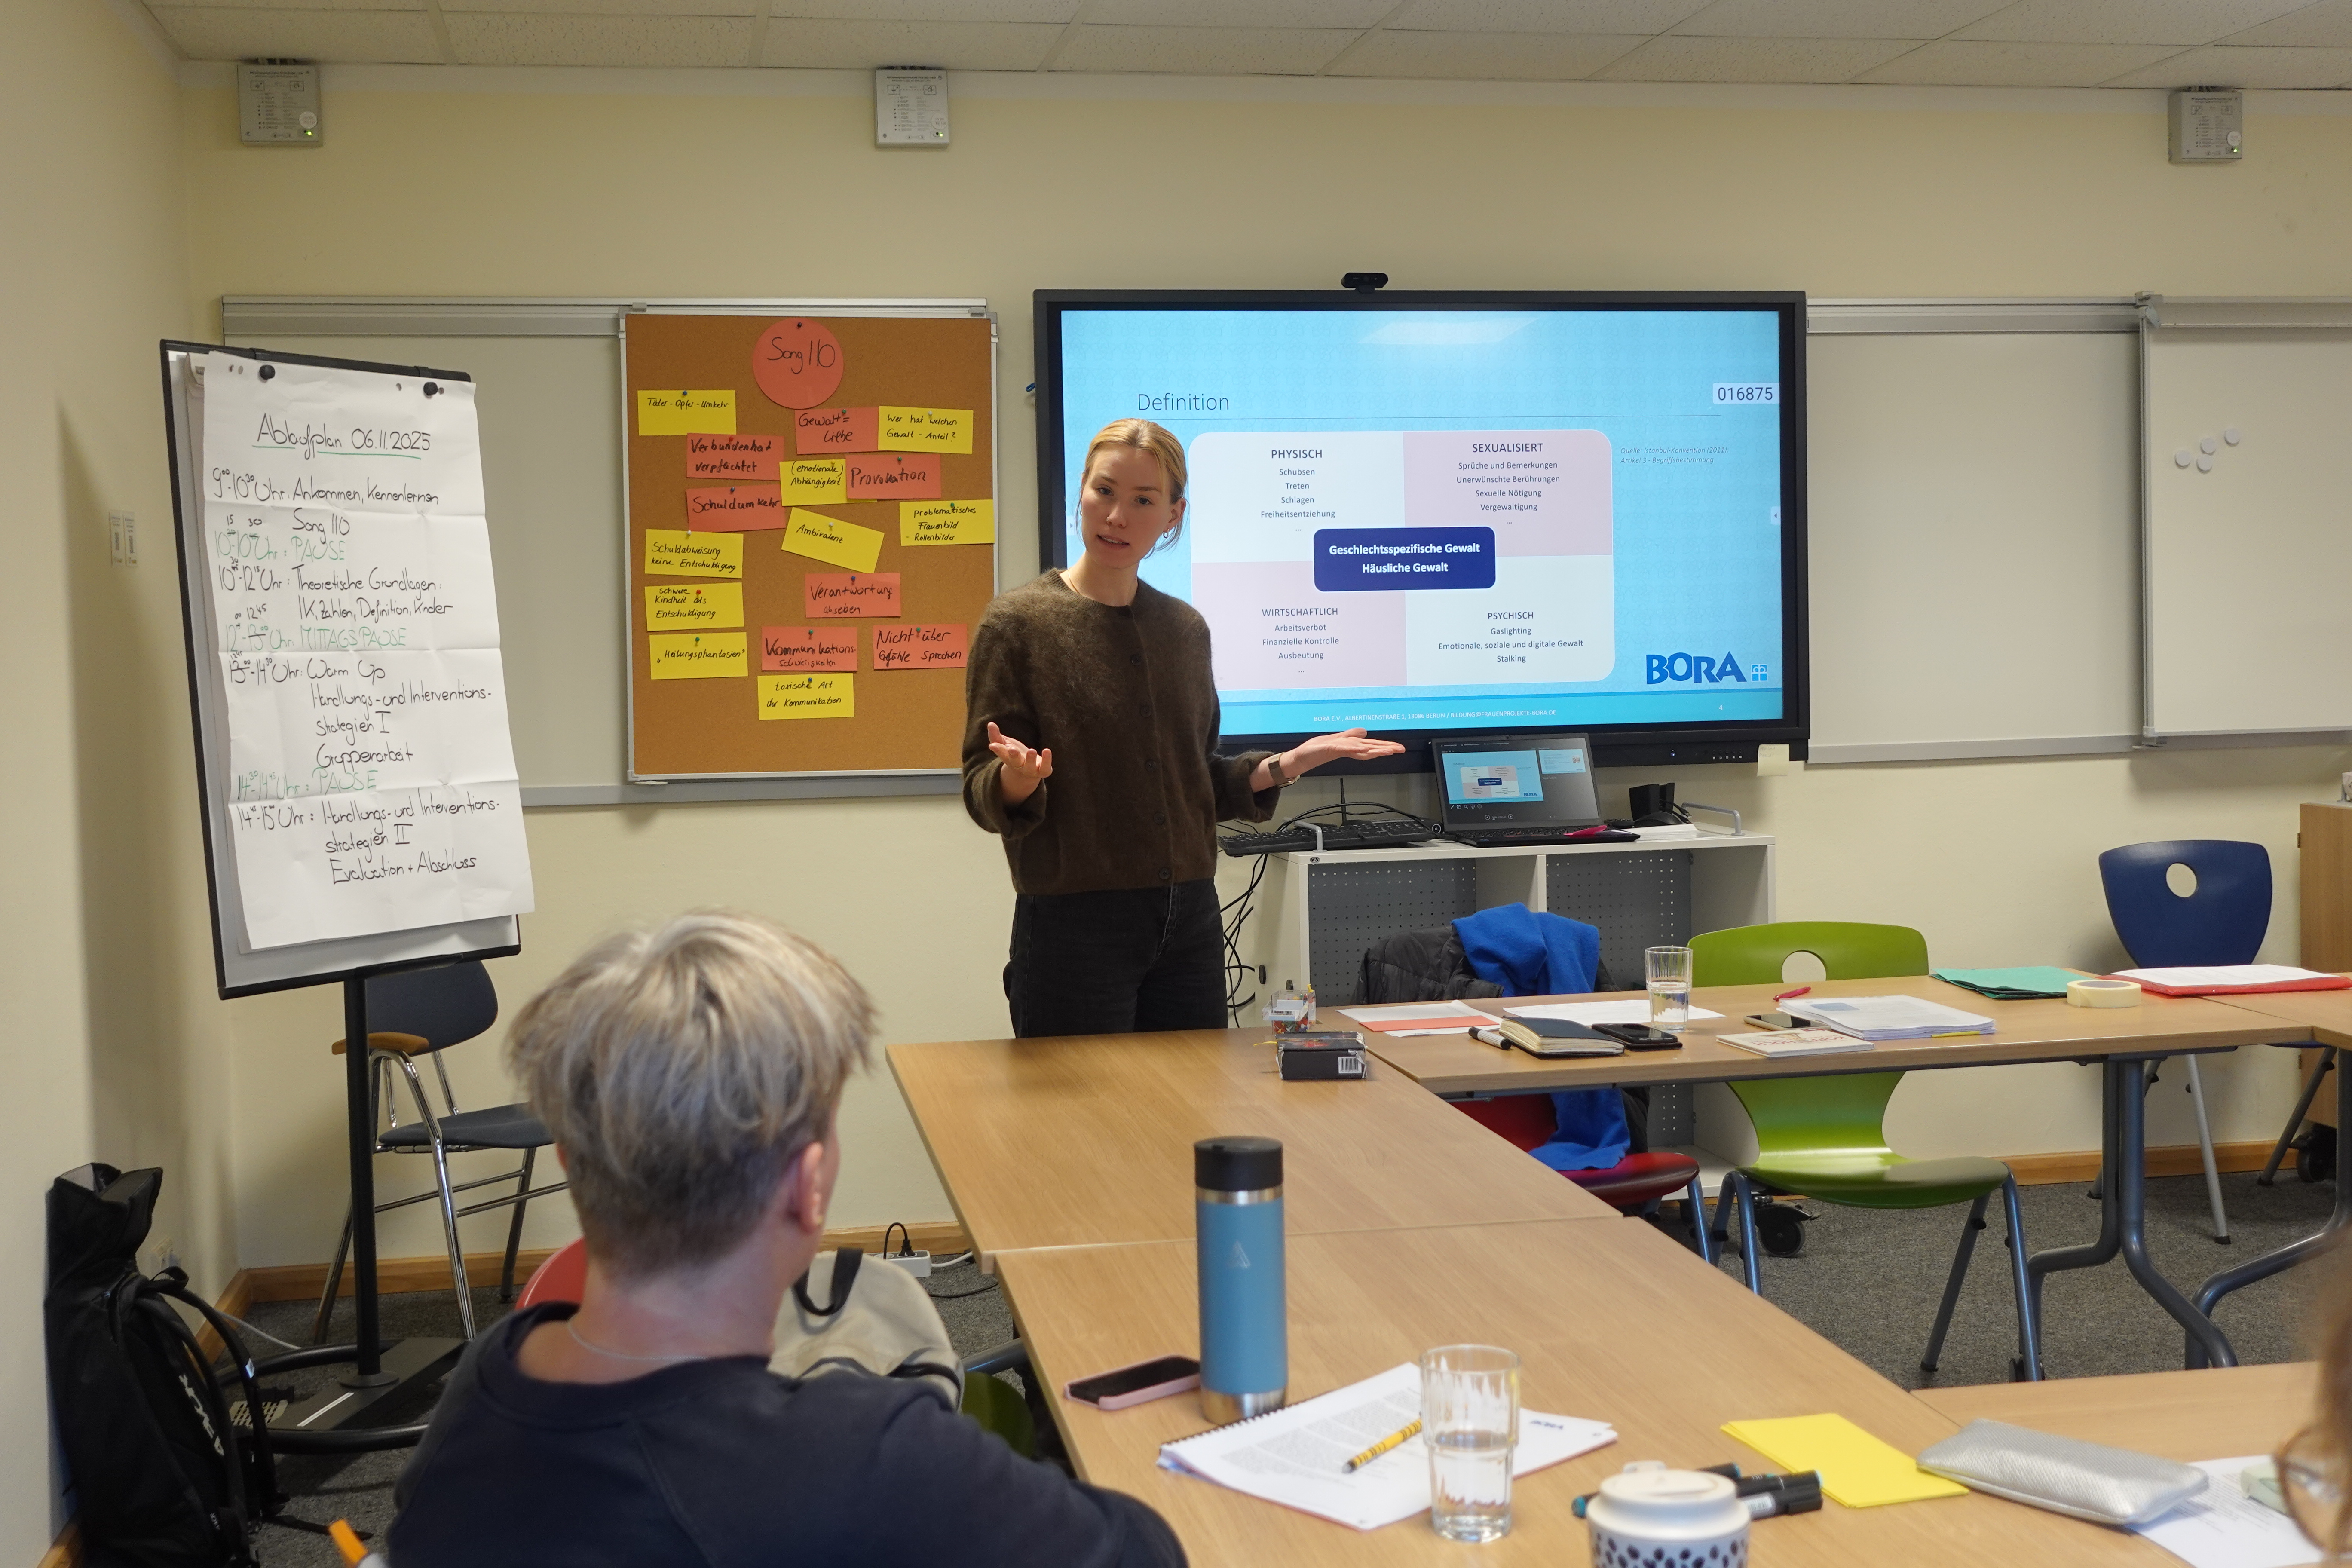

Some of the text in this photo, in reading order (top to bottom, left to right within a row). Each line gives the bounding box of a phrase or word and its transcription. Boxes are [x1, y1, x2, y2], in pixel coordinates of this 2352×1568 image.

[767, 337, 836, 374] Song 110
[1718, 386, 1774, 401] 016875
[675, 399, 694, 410] Opfer
[701, 399, 729, 408] Umkehr
[1138, 392, 1230, 411] Definition
[910, 414, 923, 423] hat
[929, 417, 958, 426] welchen
[257, 413, 431, 460] Ablaufplan 06.11.2025
[824, 430, 853, 443] Liebe
[886, 428, 914, 438] Gewalt
[1271, 448, 1323, 459] PHYSISCH
[1472, 443, 1544, 453] SEXUALISIERT
[1620, 446, 1729, 455] Quelle: Istanbul-Konvention (2011):
[1458, 460, 1558, 471] Sprüche und Bemerkungen
[1620, 456, 1642, 464] Artikel
[1652, 456, 1715, 465] Begriffsbestimmung
[791, 461, 844, 477] (emotionale)
[1279, 467, 1316, 476] Schubsen
[790, 476, 841, 488] Abhängigkeit
[851, 467, 926, 488] Provokation
[1456, 475, 1561, 484] Unerwünschte Berührungen
[293, 475, 364, 504] Ankommen,
[367, 477, 439, 505] Kennenlernen
[1285, 482, 1310, 490] Treten
[1475, 489, 1542, 499] Sexuelle Nötigung
[1280, 496, 1315, 505] Schlagen
[913, 506, 977, 518] problematisches
[1480, 503, 1538, 512] Vergewaltigung
[1260, 509, 1336, 519] Freiheitsentziehung
[292, 507, 350, 544] Song 110
[918, 521, 959, 530] Frauenbild
[914, 533, 956, 542] Rollenbilder
[291, 535, 345, 560] PAUSE
[651, 541, 721, 560] Schuldabweisung
[1329, 542, 1481, 557] Geschlechtsspezifische Gewalt
[680, 558, 736, 573] Entschuldigung
[1362, 561, 1449, 573] Häusliche Gewalt
[291, 563, 364, 591] Theoretische
[810, 582, 893, 601] Verantwortung
[655, 595, 687, 604] Kindheit
[318, 597, 357, 621] Zahlen,
[357, 597, 411, 624] Definition,
[413, 597, 453, 616] Kinder
[656, 609, 717, 620] Entschuldigung
[1261, 607, 1338, 617] WIRTSCHAFTLICH
[1487, 611, 1534, 620] PSYCHISCH
[1274, 623, 1327, 632] Arbeitsverbot
[1490, 627, 1532, 636] Gaslighting
[876, 628, 952, 649] Nicht über
[1262, 636, 1340, 646] Finanzielle Kontrolle
[1438, 639, 1584, 651] Emotionale, soziale und digitale Gewalt
[879, 650, 910, 668] Gefühle
[1278, 651, 1324, 661] Ausbeutung
[1497, 654, 1527, 664] Stalking
[307, 657, 349, 681] Warm
[358, 658, 386, 686] Up
[1646, 651, 1747, 685] BORA
[410, 678, 492, 704] Interventions-
[775, 680, 833, 692] toxische Art
[784, 696, 842, 708] Kommunikation
[1450, 709, 1556, 718] BILDUNG@FRAUENPROJEKTE-BORA.DE
[316, 741, 414, 773] Gruppenarbeit
[312, 766, 379, 795] PAUSE
[417, 787, 500, 816] Interventions-
[393, 824, 413, 845] II
[329, 854, 404, 885] Evaluation
[416, 848, 477, 874] Abschluss
